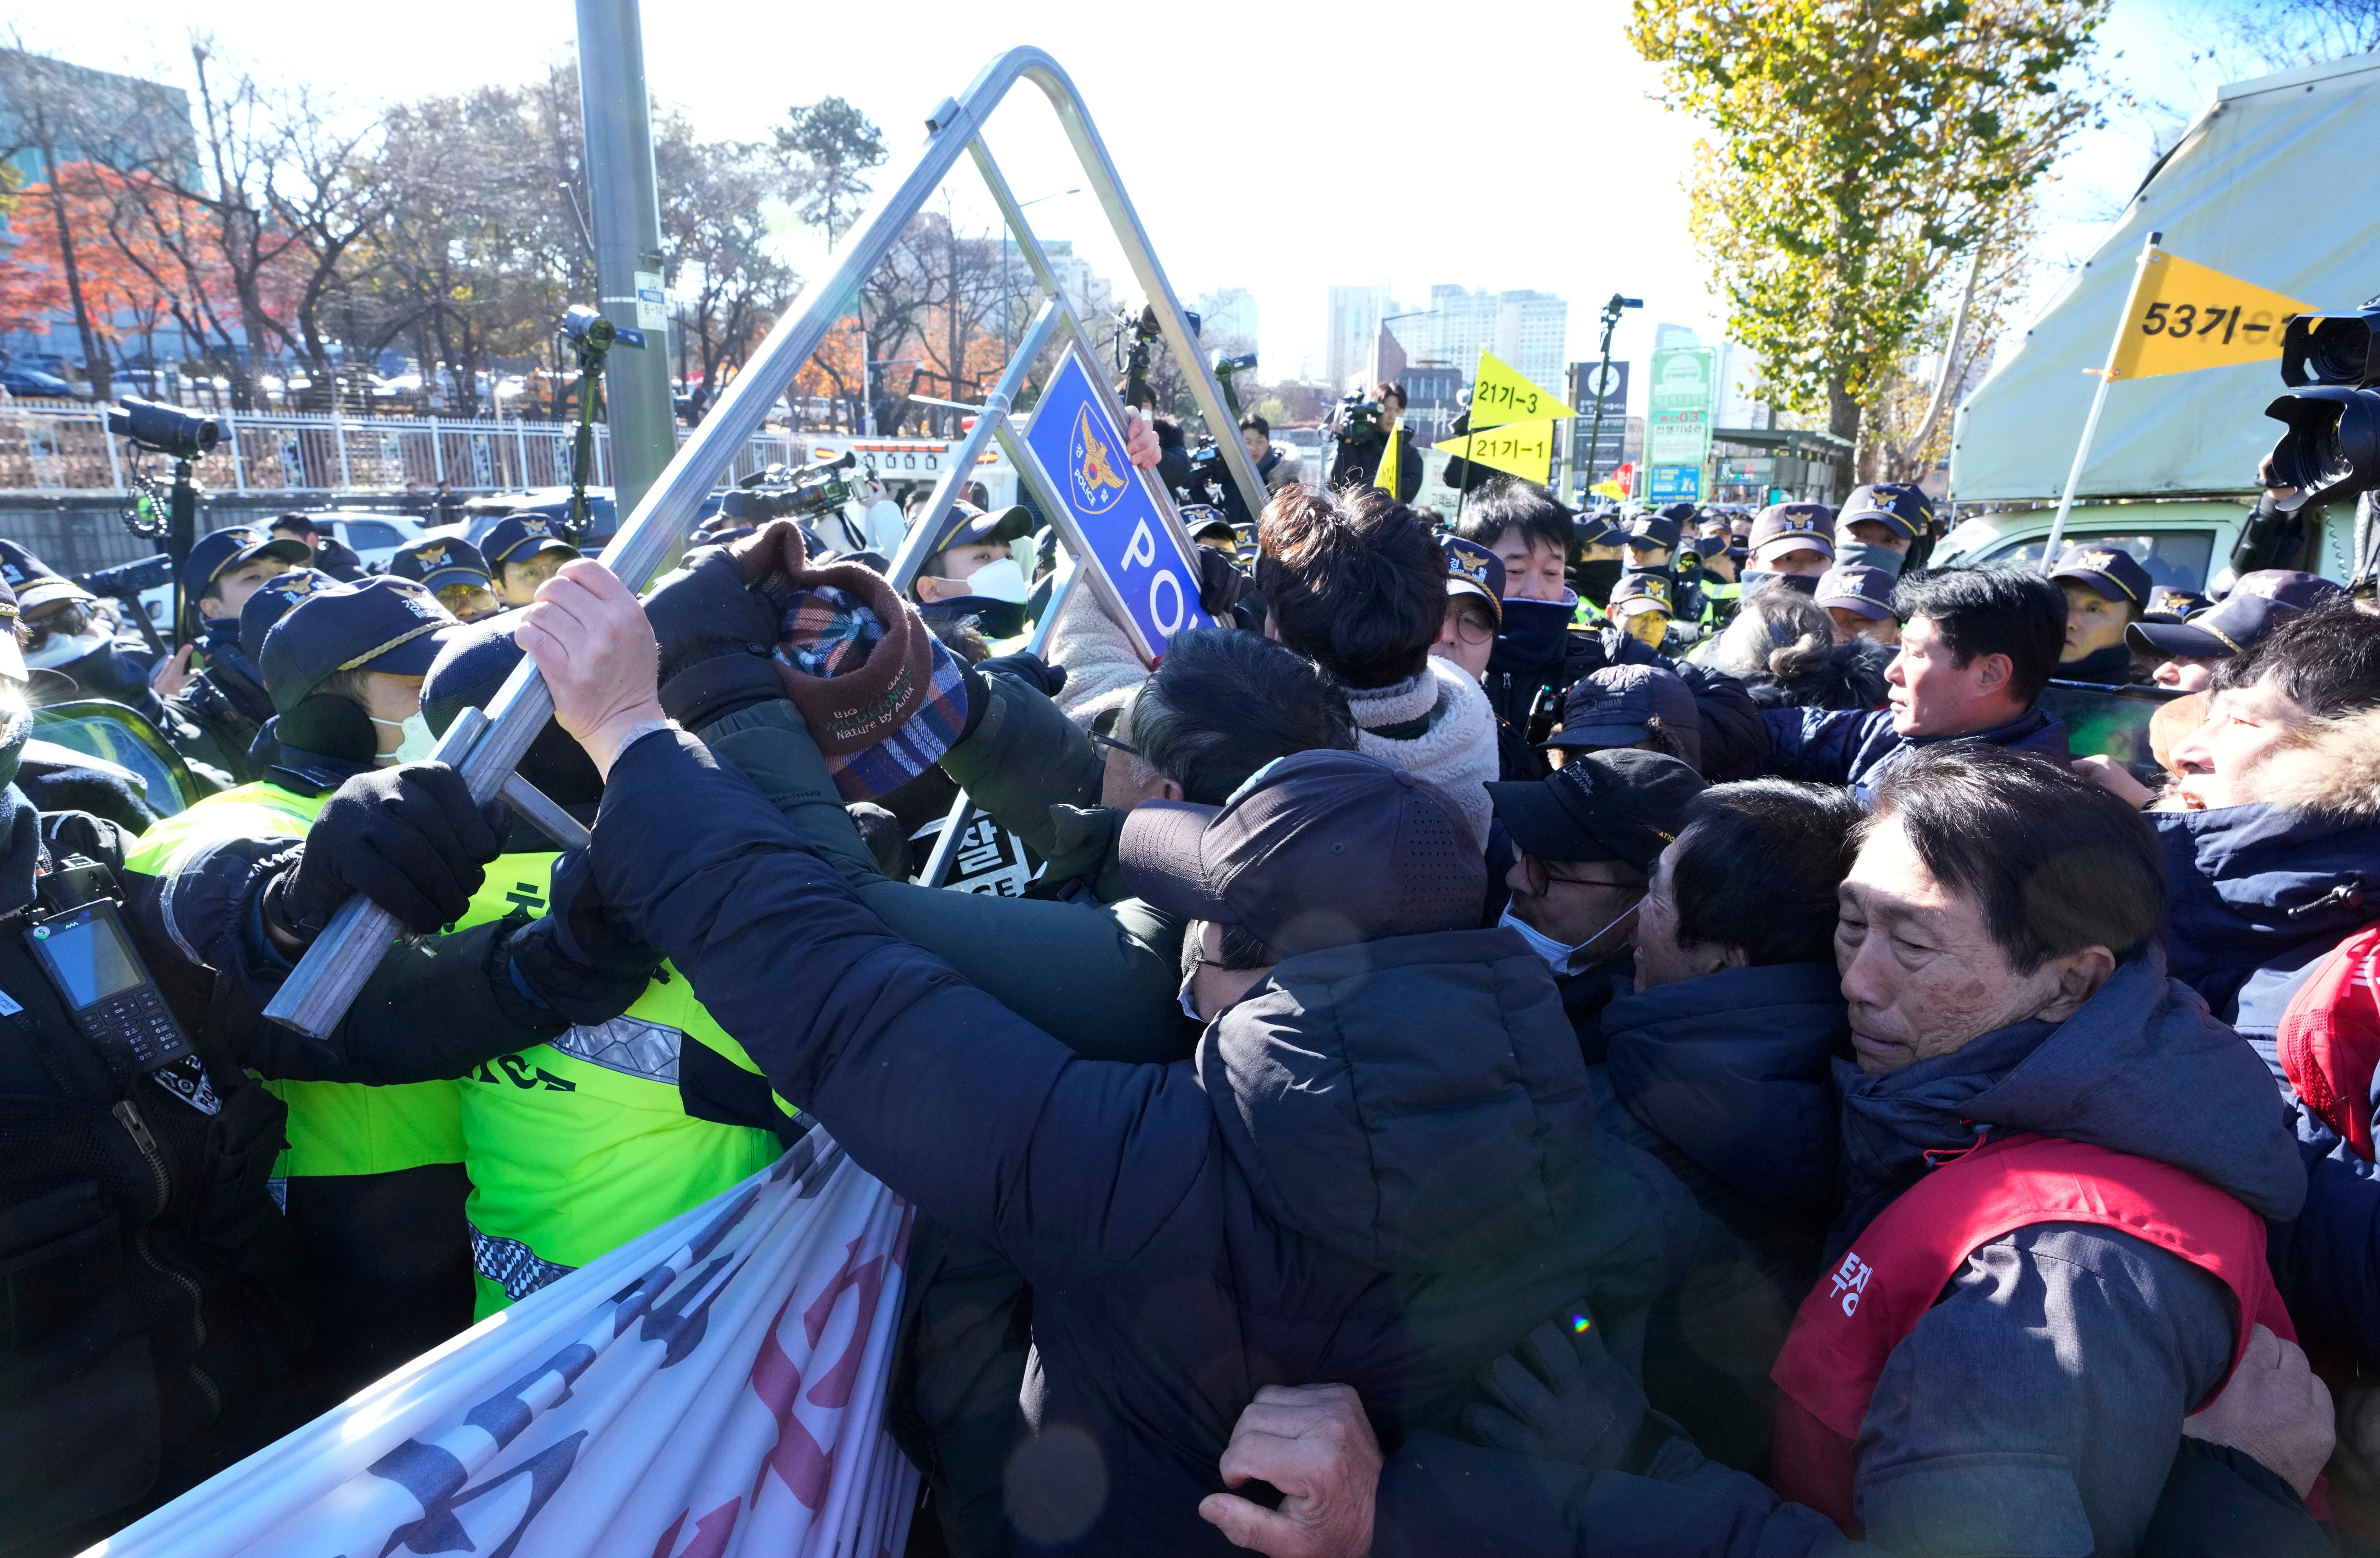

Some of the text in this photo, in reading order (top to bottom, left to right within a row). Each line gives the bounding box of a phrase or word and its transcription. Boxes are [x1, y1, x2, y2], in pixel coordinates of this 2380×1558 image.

[1479, 381, 1538, 414] 21기-3
[1476, 439, 1543, 459] 21기-1
[1074, 468, 1096, 507] POLICE
[1121, 518, 1198, 638] PO
[1450, 558, 1459, 568] 경
[836, 721, 877, 740] Nature
[879, 710, 892, 723] by
[1569, 770, 1593, 797] GEOGRAPHIC
[1576, 766, 1595, 787] NATIONAL
[1829, 1251, 1874, 1317] 투쟁
